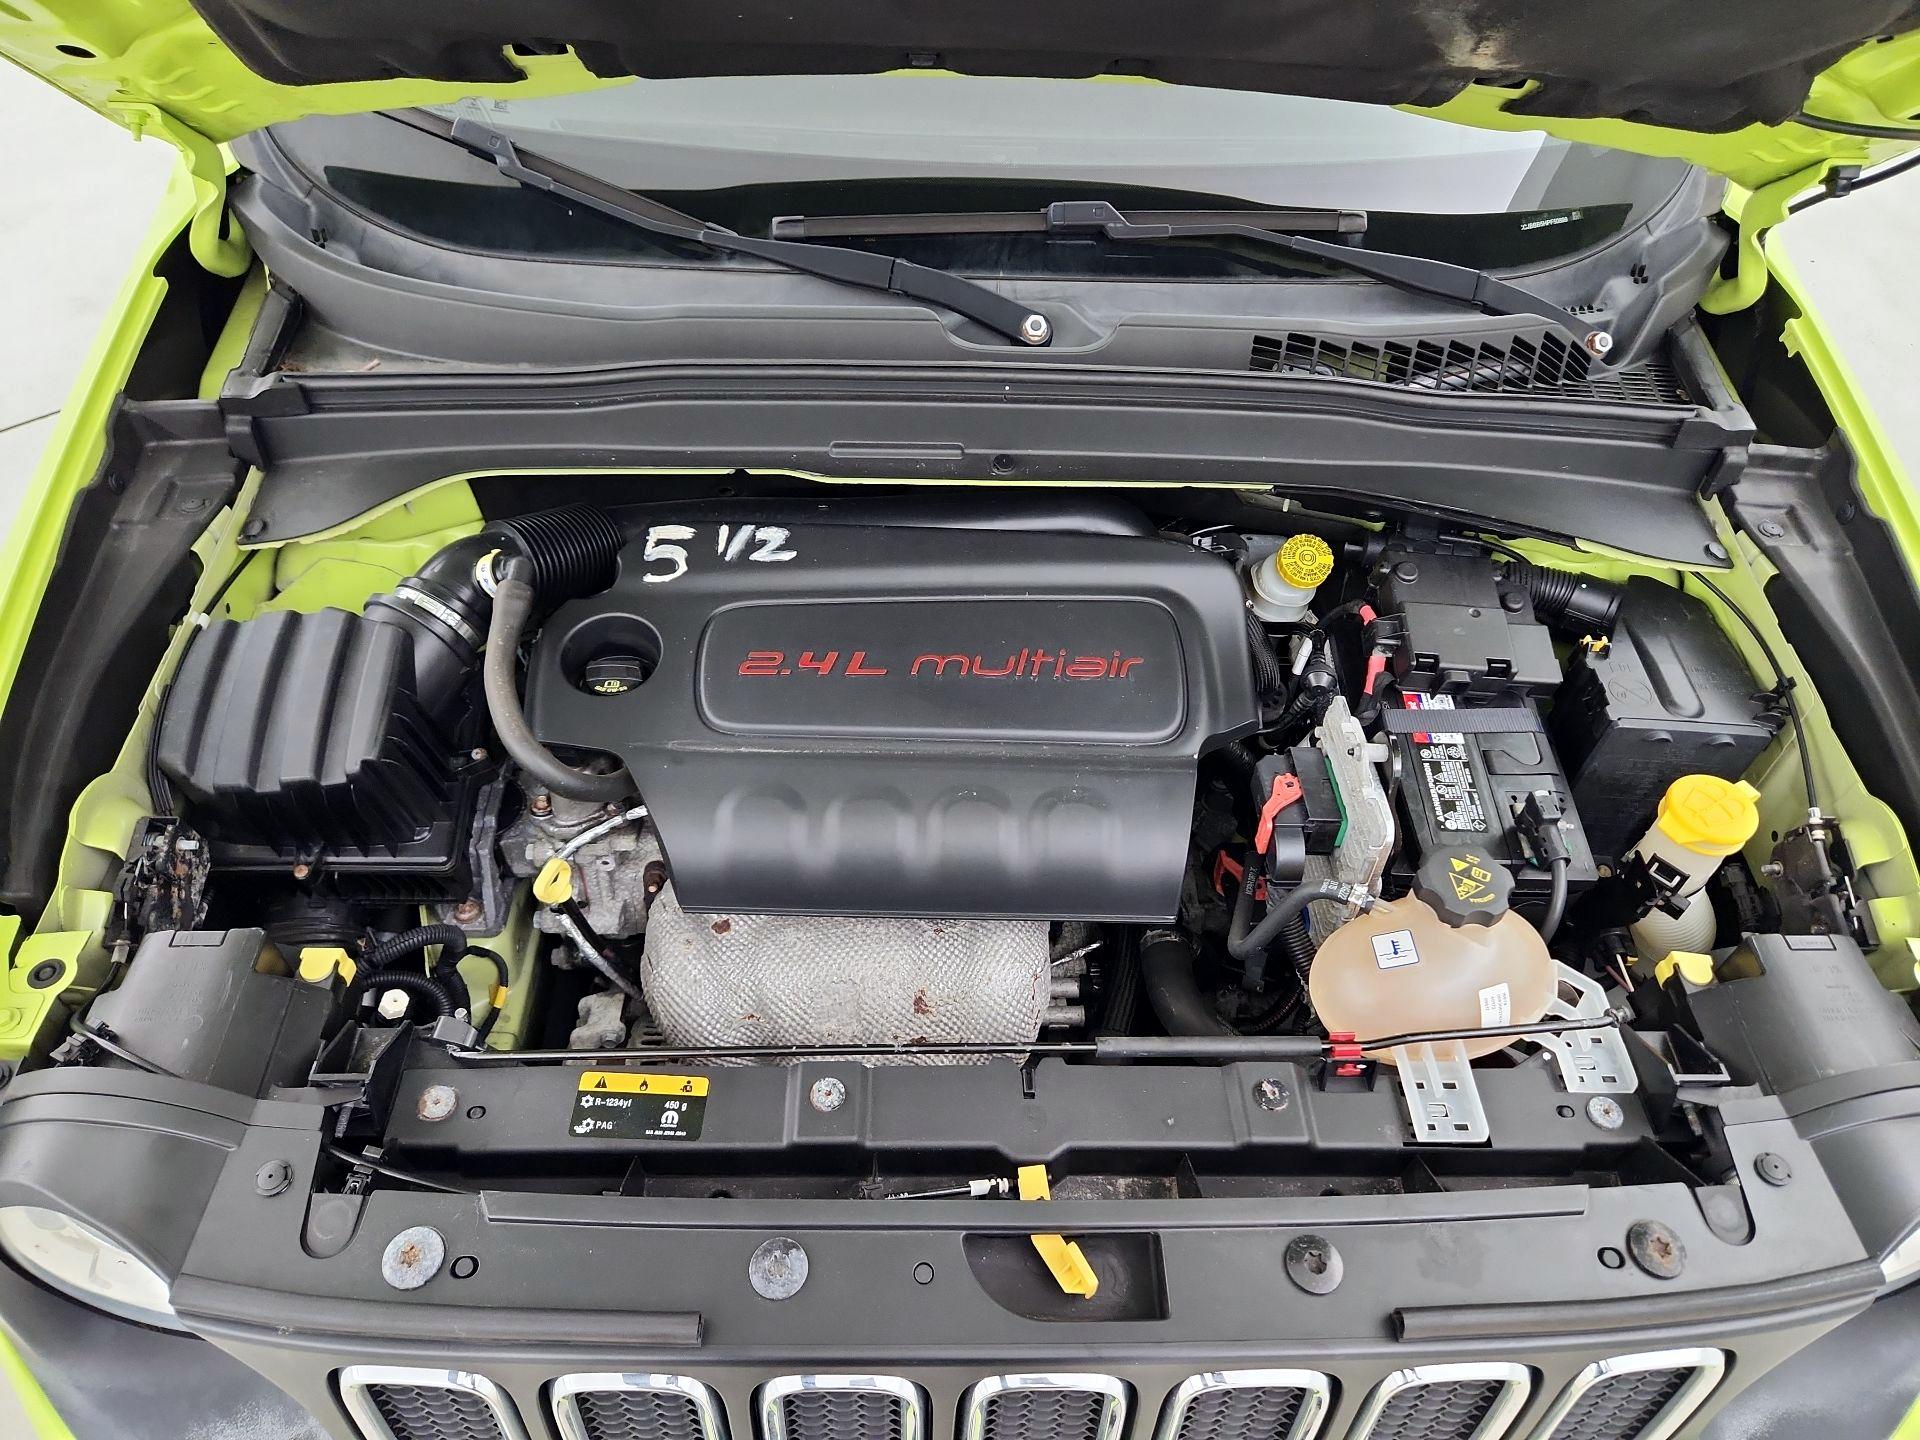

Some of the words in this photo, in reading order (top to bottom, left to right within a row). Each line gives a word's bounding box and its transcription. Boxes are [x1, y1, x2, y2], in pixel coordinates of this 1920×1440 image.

[643, 524, 698, 582] 5
[911, 647, 1144, 678] multiair
[594, 1097, 632, 1107] R-1234yf
[664, 1100, 680, 1110] 450
[681, 1102, 687, 1111] g
[595, 1121, 613, 1130] PAG
